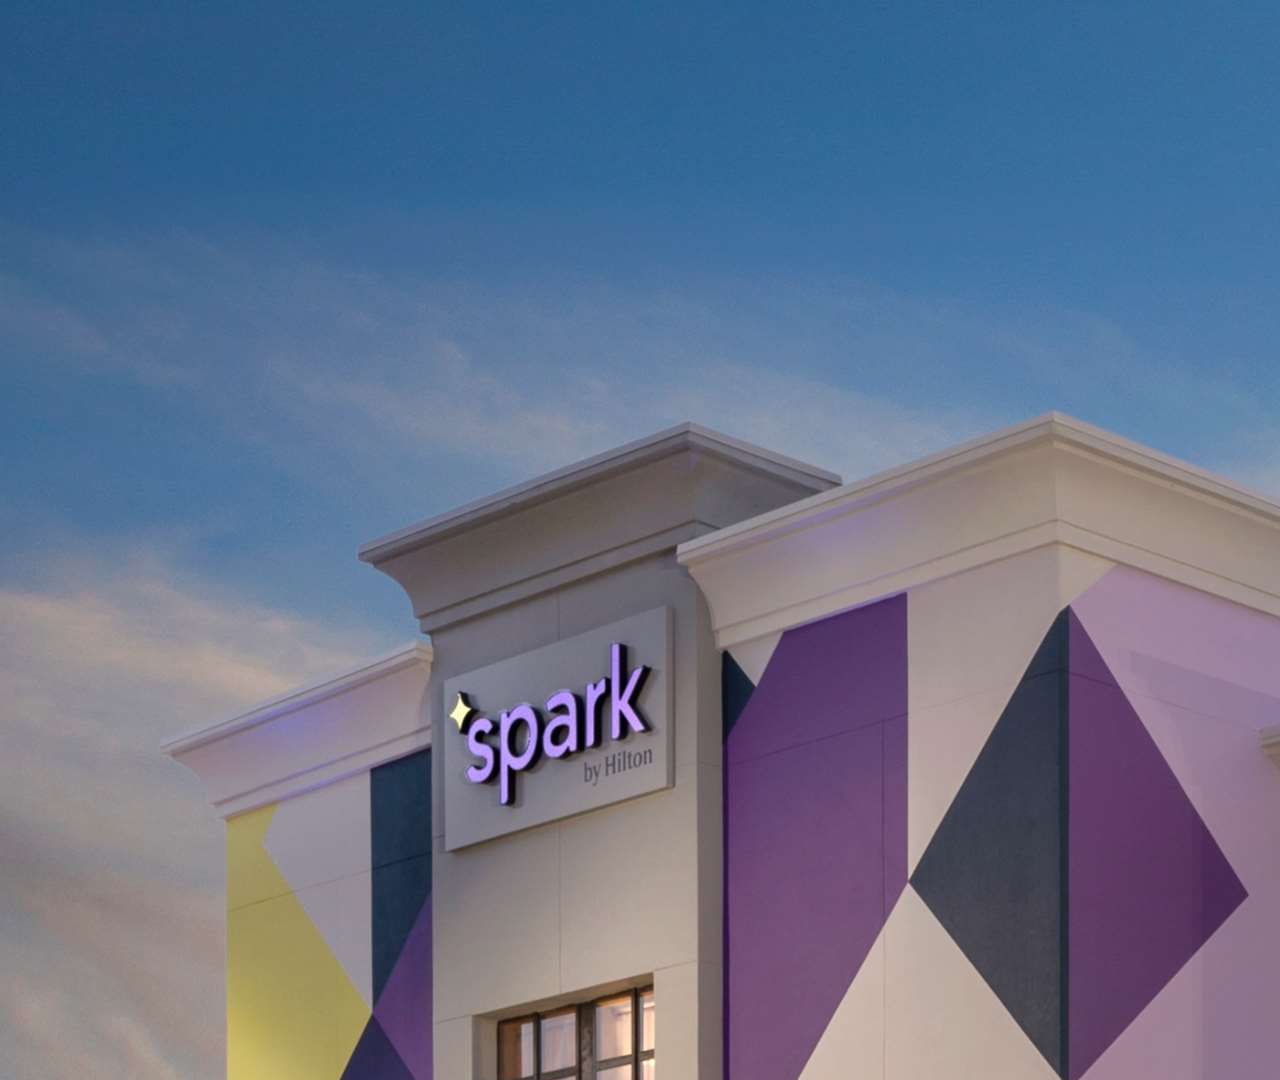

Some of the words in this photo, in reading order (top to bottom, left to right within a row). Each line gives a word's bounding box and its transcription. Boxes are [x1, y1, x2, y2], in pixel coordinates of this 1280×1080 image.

[465, 642, 650, 806] spark
[583, 761, 602, 785] by
[604, 748, 653, 777] Hilton
